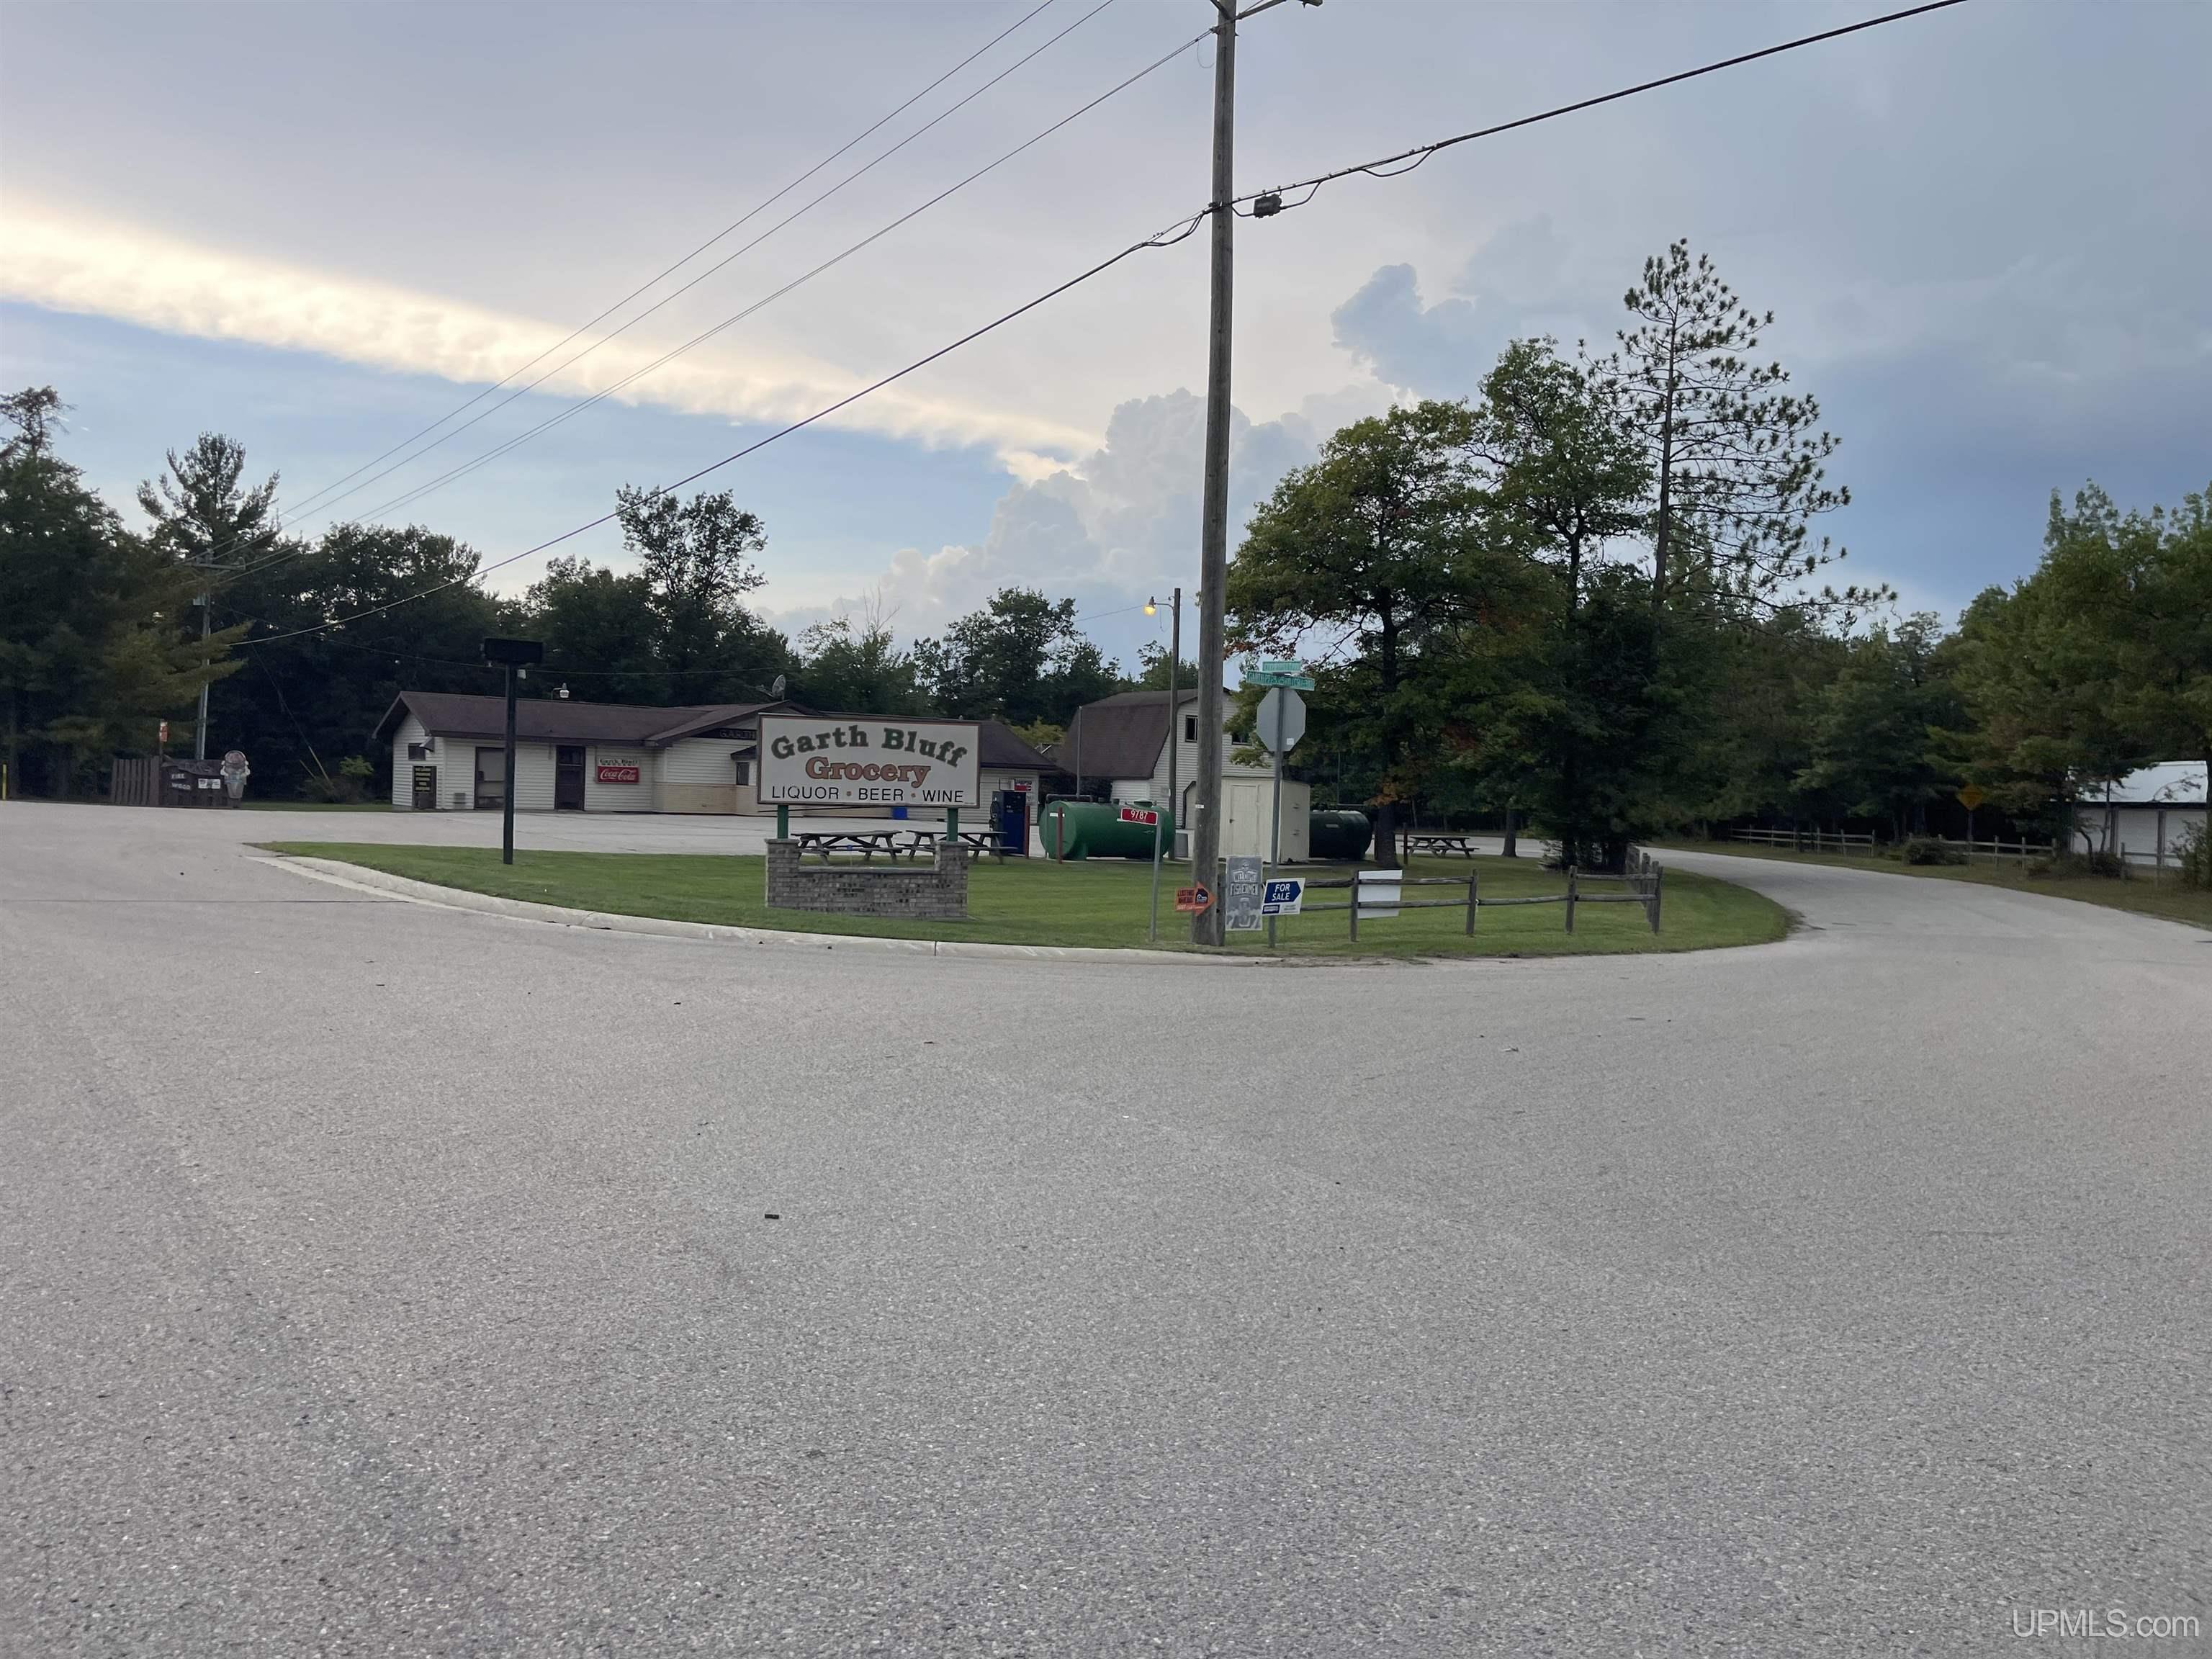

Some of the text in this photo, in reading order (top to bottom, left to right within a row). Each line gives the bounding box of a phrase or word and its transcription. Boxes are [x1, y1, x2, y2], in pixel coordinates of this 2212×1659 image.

[771, 725, 967, 767] Garth Bluff
[806, 756, 931, 788] Grocery
[772, 786, 964, 803] LIQUOR BEER WINE
[1130, 810, 1148, 820] 9787
[1231, 883, 1258, 896] FISHERMEN
[1274, 884, 1290, 893] FOR
[1272, 892, 1290, 901] SALE
